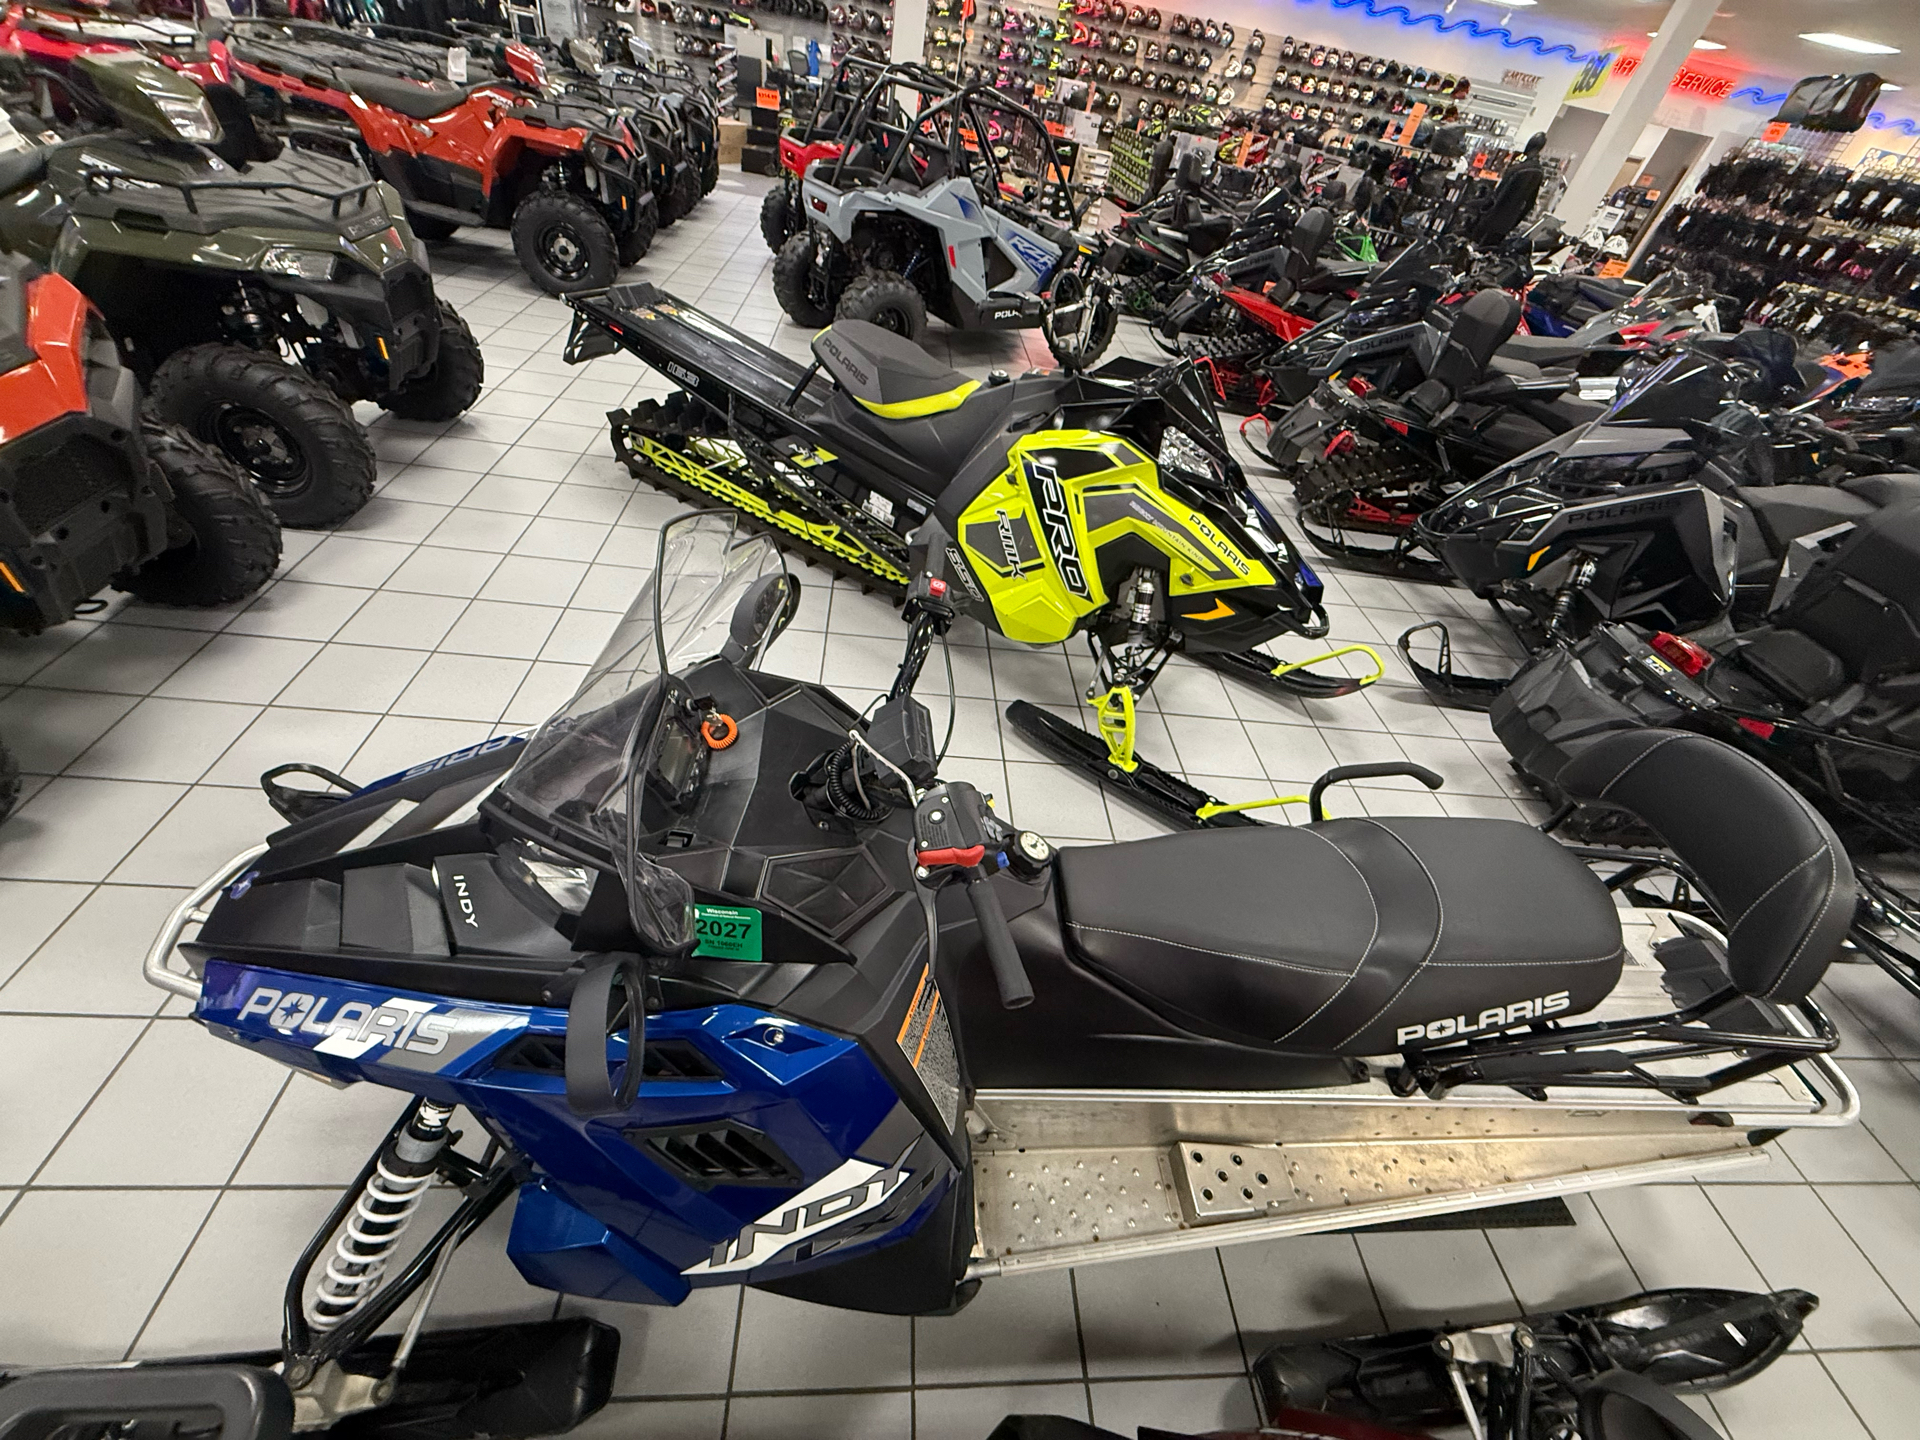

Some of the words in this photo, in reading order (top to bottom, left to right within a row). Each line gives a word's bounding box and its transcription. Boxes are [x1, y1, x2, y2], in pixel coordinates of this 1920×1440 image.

[1612, 56, 1643, 76] ART
[1670, 65, 1735, 99] SERVICE
[1008, 235, 1057, 269] RZR
[821, 338, 870, 387] POLARIS
[1348, 331, 1416, 352] POLARIS
[1032, 462, 1089, 597] PRO
[1568, 497, 1682, 525] POLARIS
[995, 508, 1027, 582] RMK
[1186, 547, 1204, 563] KING
[1188, 513, 1251, 577] POLARIS
[945, 546, 985, 603] 850
[400, 736, 513, 782] ARIS
[452, 874, 480, 929] INDY
[706, 907, 739, 916] Wisconsin
[695, 919, 752, 939] 2027
[237, 986, 461, 1056] POLARIS
[1395, 990, 1570, 1046] POLARIS
[710, 1132, 925, 1268] INDY
